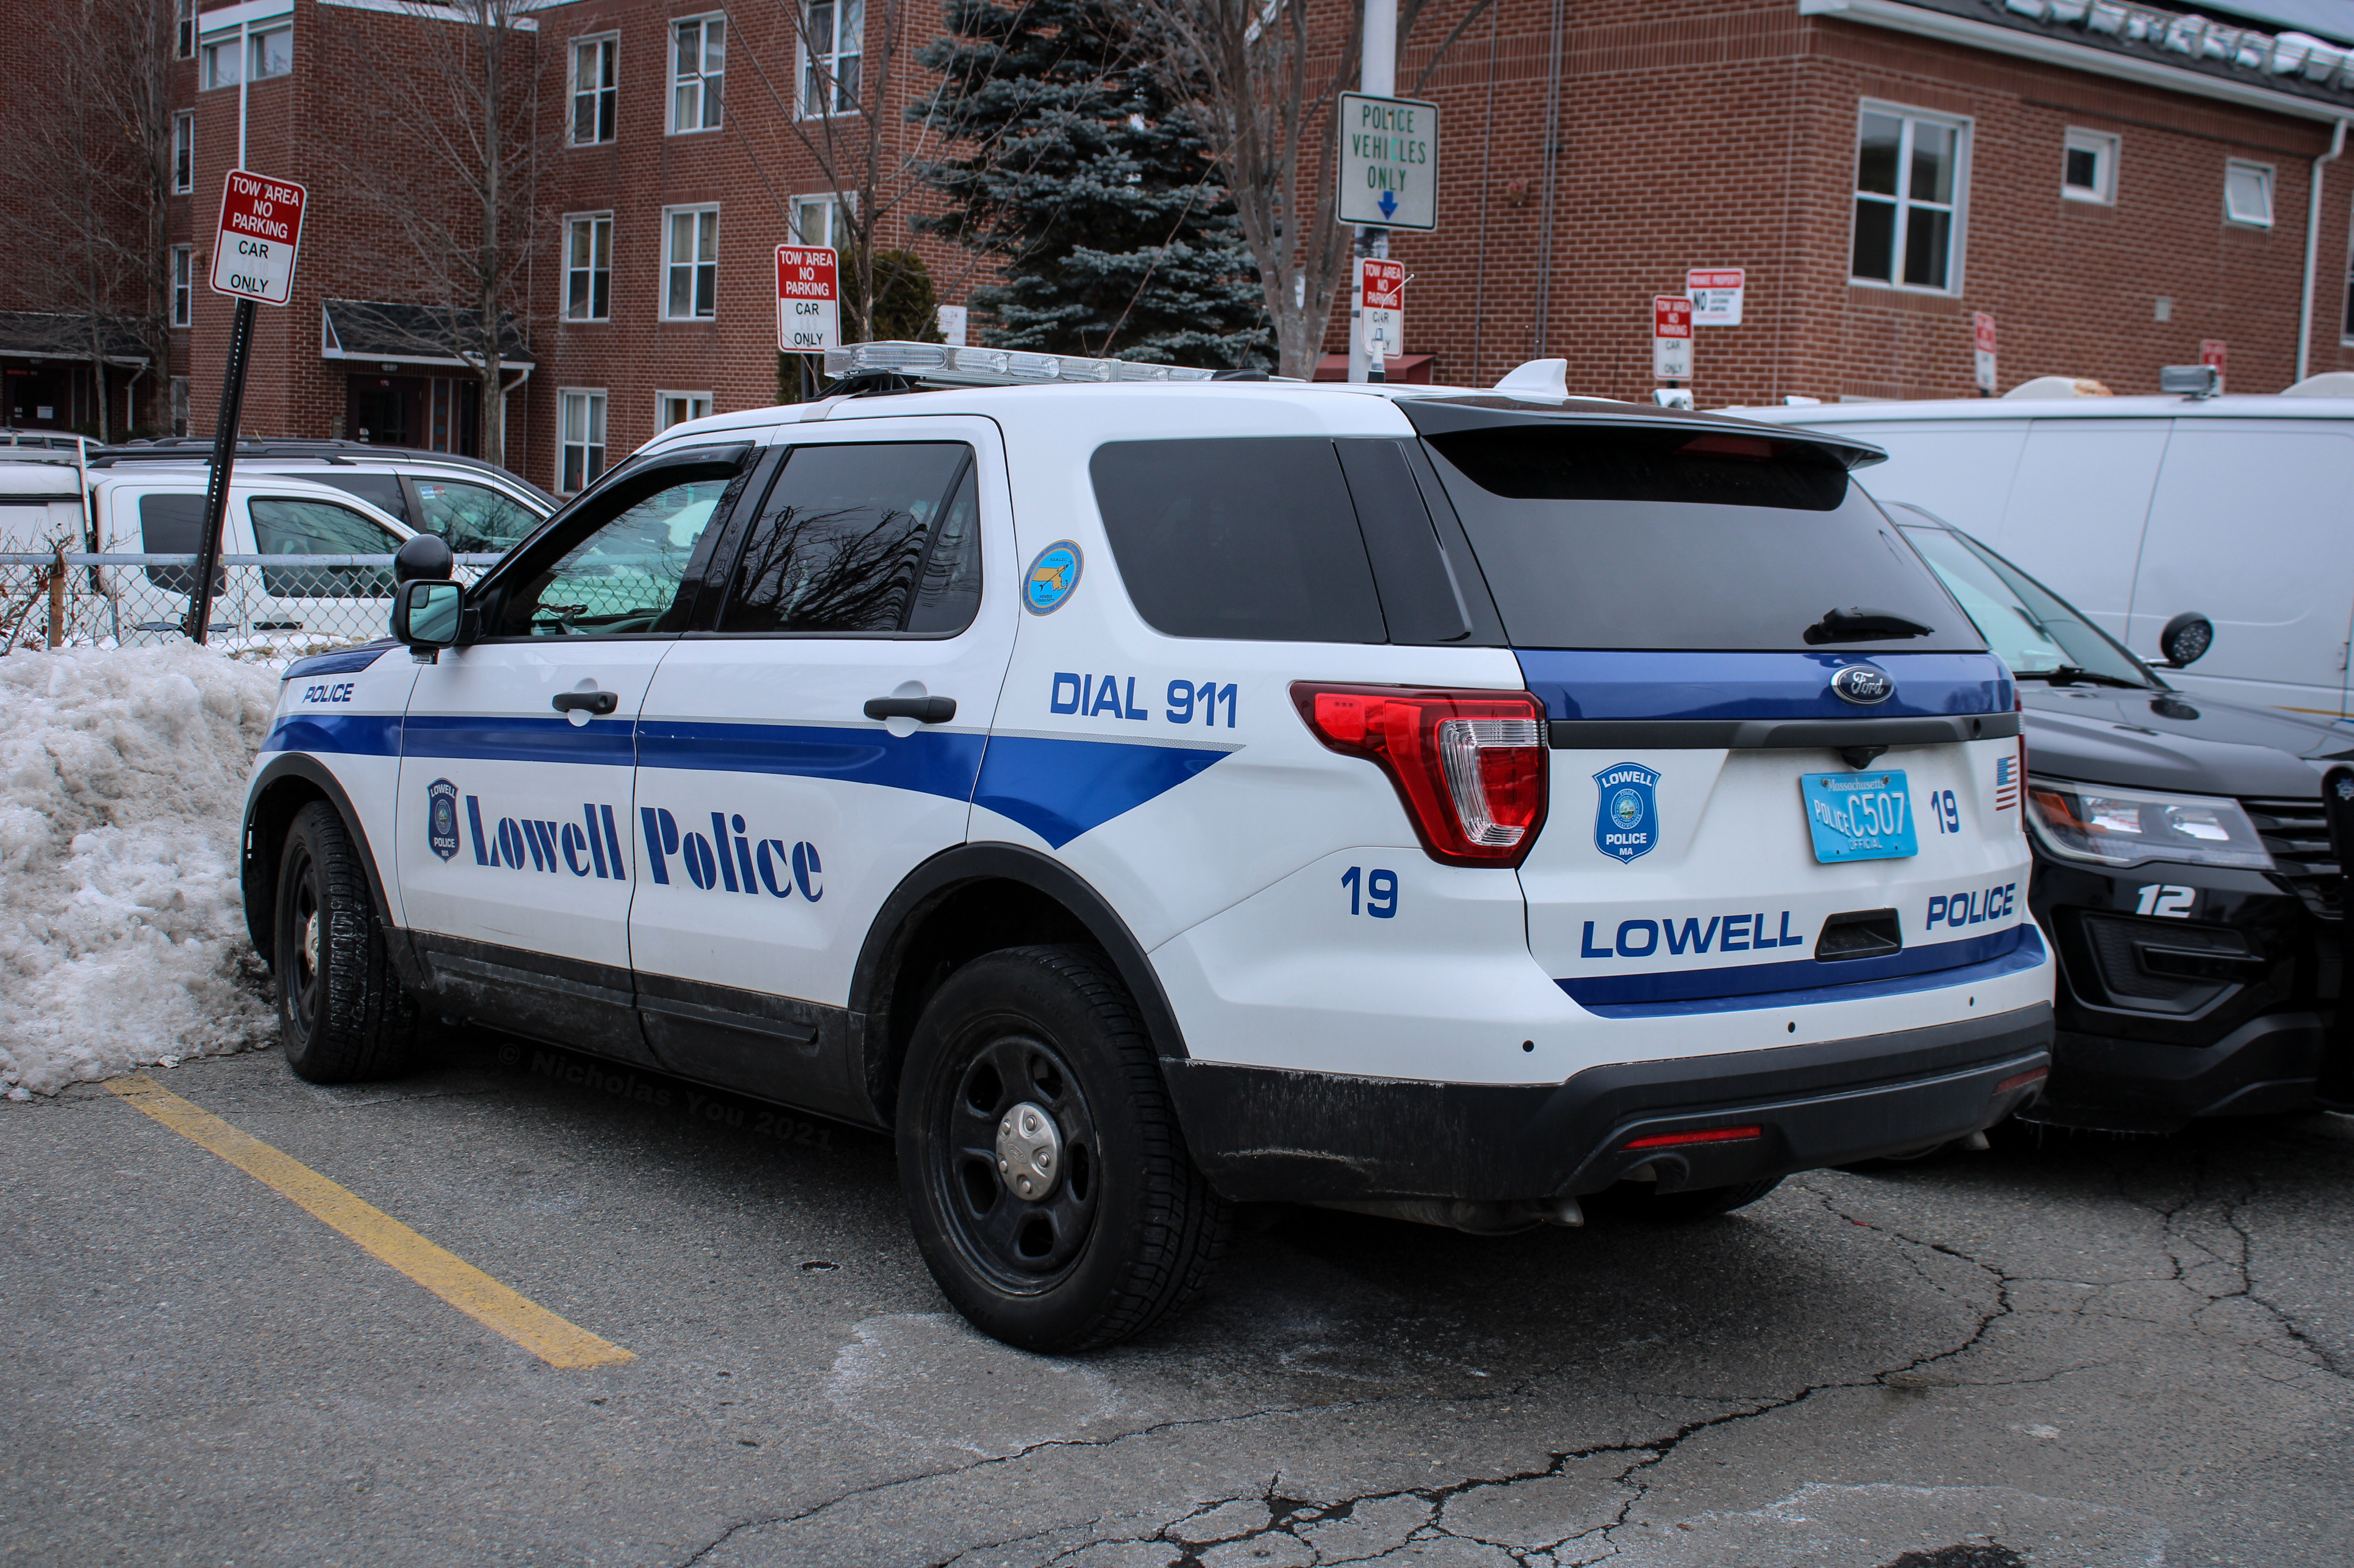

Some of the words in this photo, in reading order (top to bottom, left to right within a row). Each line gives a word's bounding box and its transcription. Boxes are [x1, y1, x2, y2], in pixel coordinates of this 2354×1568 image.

[1363, 104, 1414, 133] POLICE
[1353, 133, 1426, 164] VEHICLES
[1368, 165, 1406, 191] ONLY
[233, 176, 261, 197] TOW
[265, 185, 299, 206] AREA
[253, 200, 272, 217] NO
[232, 212, 288, 239] PARKING
[239, 240, 269, 259] CAR
[780, 251, 802, 265] TOW
[806, 253, 833, 267] AREA
[799, 267, 814, 280] NO
[1365, 264, 1380, 276] TOW
[1383, 267, 1401, 279] AREA
[231, 274, 268, 293] ONLY
[786, 281, 829, 296] PARKING
[1377, 279, 1388, 291] NO
[1367, 291, 1397, 307] PARKING
[1693, 291, 1707, 310] NO
[796, 303, 819, 315] CAR
[1373, 311, 1389, 323] CAR
[1668, 313, 1679, 323] NO
[794, 333, 823, 345] ONLY
[1666, 340, 1681, 349] CAR
[1664, 363, 1683, 375] ONLY
[1851, 672, 1884, 694] Ford
[302, 683, 355, 703] POLICE
[1050, 672, 1148, 721] DIAL
[1166, 679, 1237, 728] 911
[1601, 771, 1653, 788] LOWELL
[1828, 777, 1885, 792] Massachusetts
[430, 784, 455, 799] LOWELL
[1814, 799, 1851, 837] POLICE
[1848, 792, 1905, 837] C507
[1931, 789, 1960, 834] 19
[434, 837, 455, 848] POLICE
[1606, 833, 1647, 845] POLICE
[1849, 838, 1883, 850] OFFICIAL
[466, 795, 626, 880] Lowell
[640, 807, 823, 903] Police
[1341, 866, 1398, 919] 19
[2135, 884, 2196, 918] 12
[1580, 911, 1803, 958] LOWELL
[1926, 883, 2016, 931] POLICE
